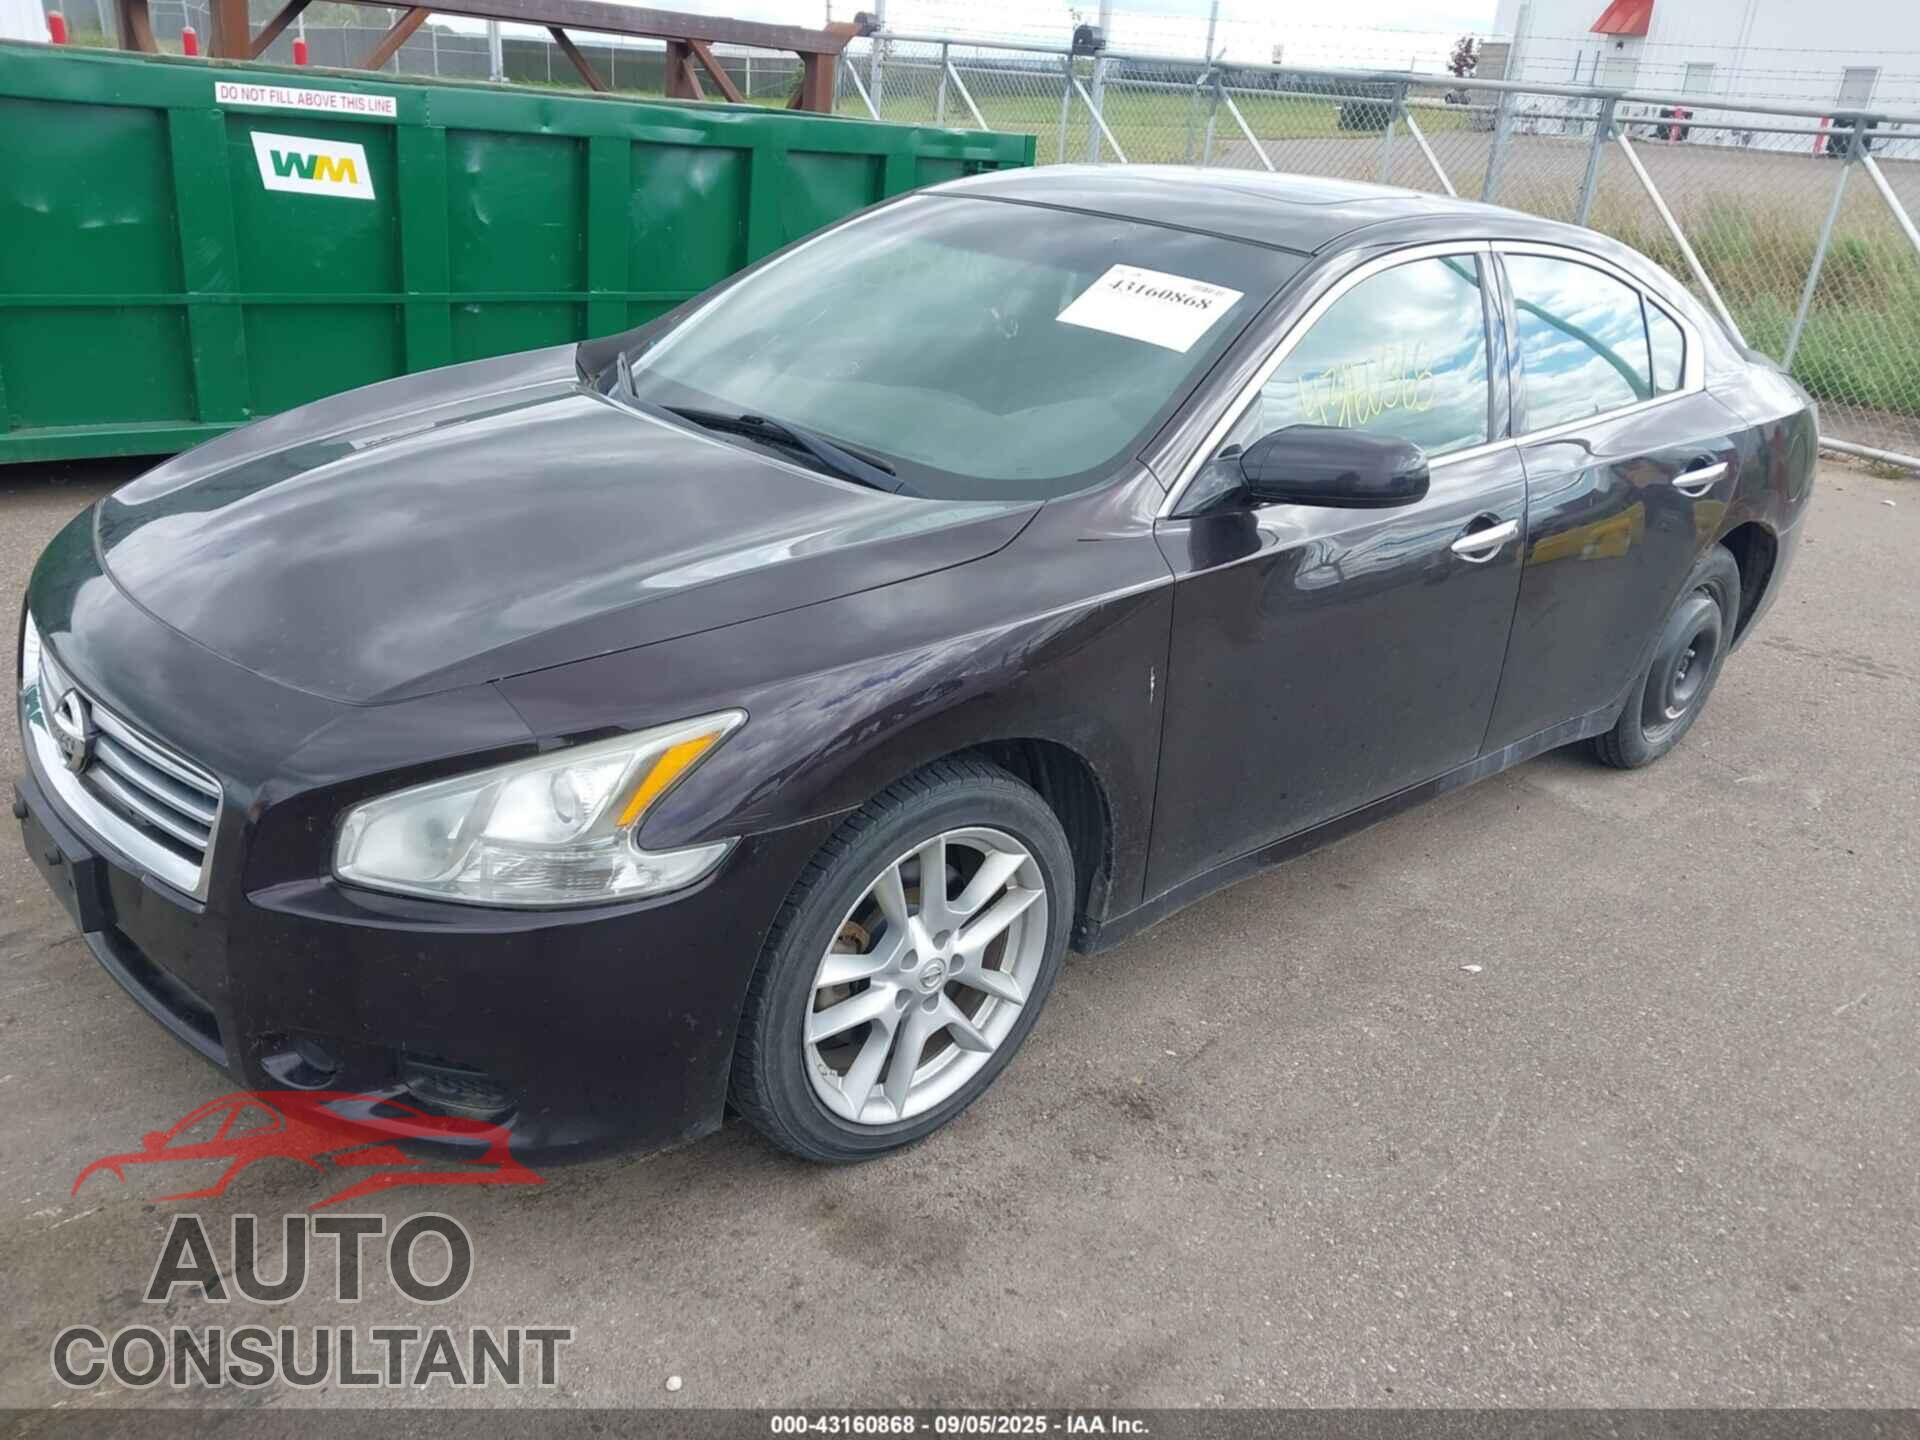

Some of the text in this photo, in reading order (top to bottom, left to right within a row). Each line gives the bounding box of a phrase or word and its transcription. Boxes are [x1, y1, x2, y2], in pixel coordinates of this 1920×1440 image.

[220, 85, 392, 113] DO NOT FILL ABOVE THIS LINE
[269, 149, 358, 184] WM
